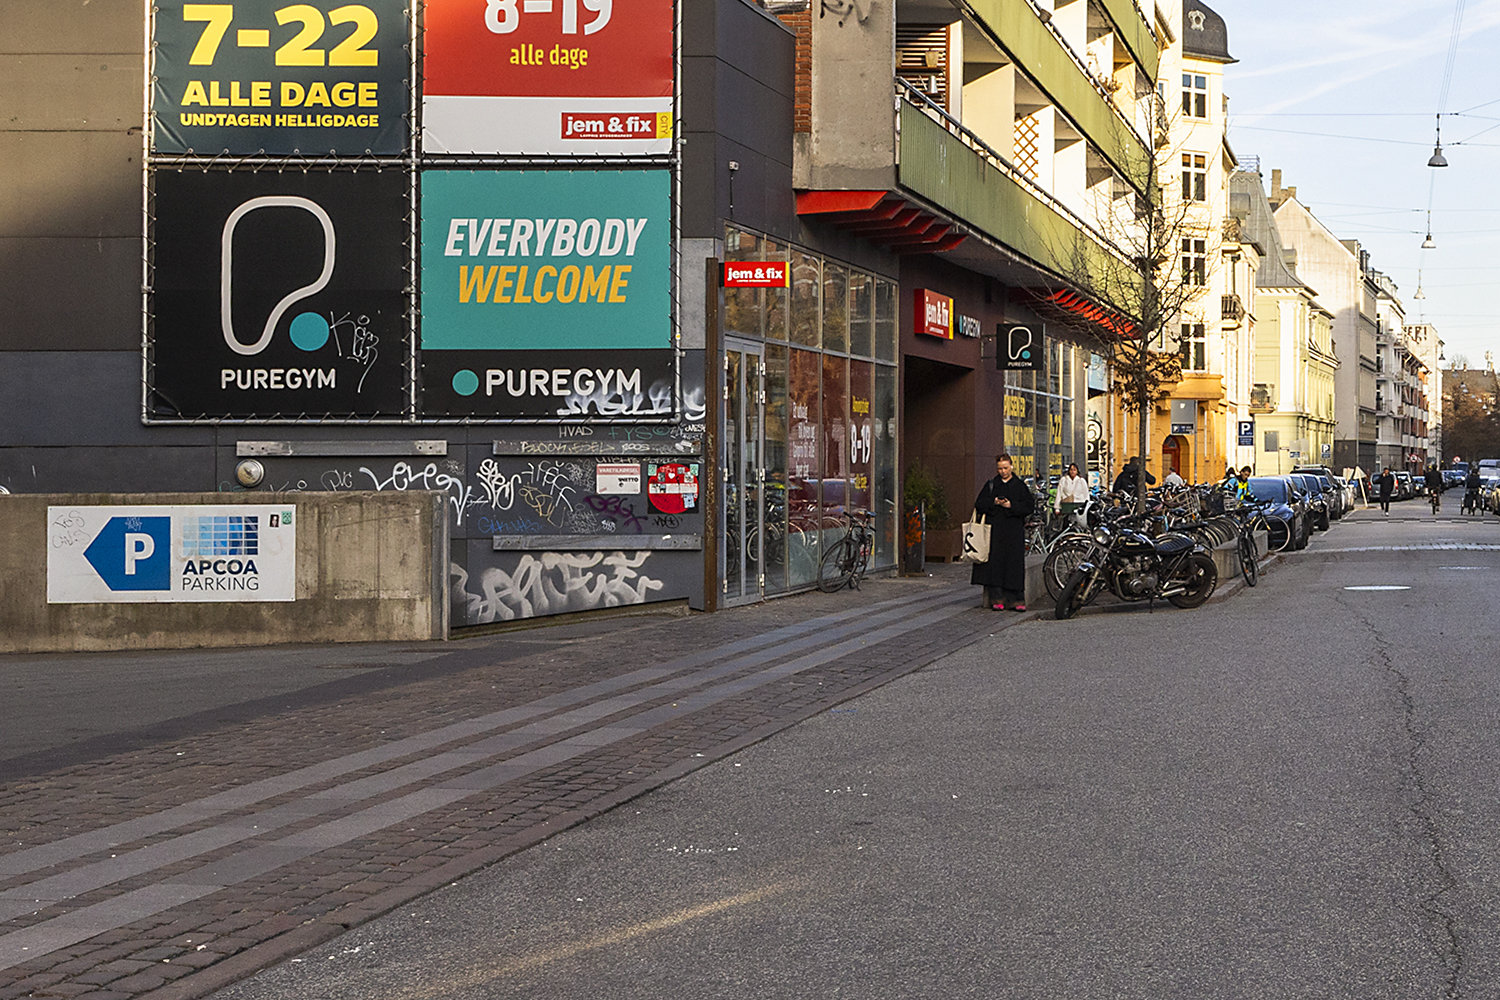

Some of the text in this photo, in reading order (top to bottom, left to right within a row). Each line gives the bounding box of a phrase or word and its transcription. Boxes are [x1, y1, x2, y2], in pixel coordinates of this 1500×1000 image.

[183, 4, 379, 67] 7-22
[510, 44, 588, 69] alle dage
[181, 81, 379, 108] ALLE DAGE
[180, 113, 379, 128] UNDTAGEN HELLIGDAGE
[566, 116, 652, 136] jem & fix
[659, 115, 669, 135] CITY
[444, 218, 648, 257] EVERYBODY
[459, 265, 632, 304] WELCOME
[727, 267, 783, 281] jem & fix
[221, 368, 336, 390] PUREGYM
[485, 368, 641, 397] PUREGYM
[125, 533, 155, 575] P
[182, 560, 258, 575] APCOA
[182, 577, 259, 591] PARKING
